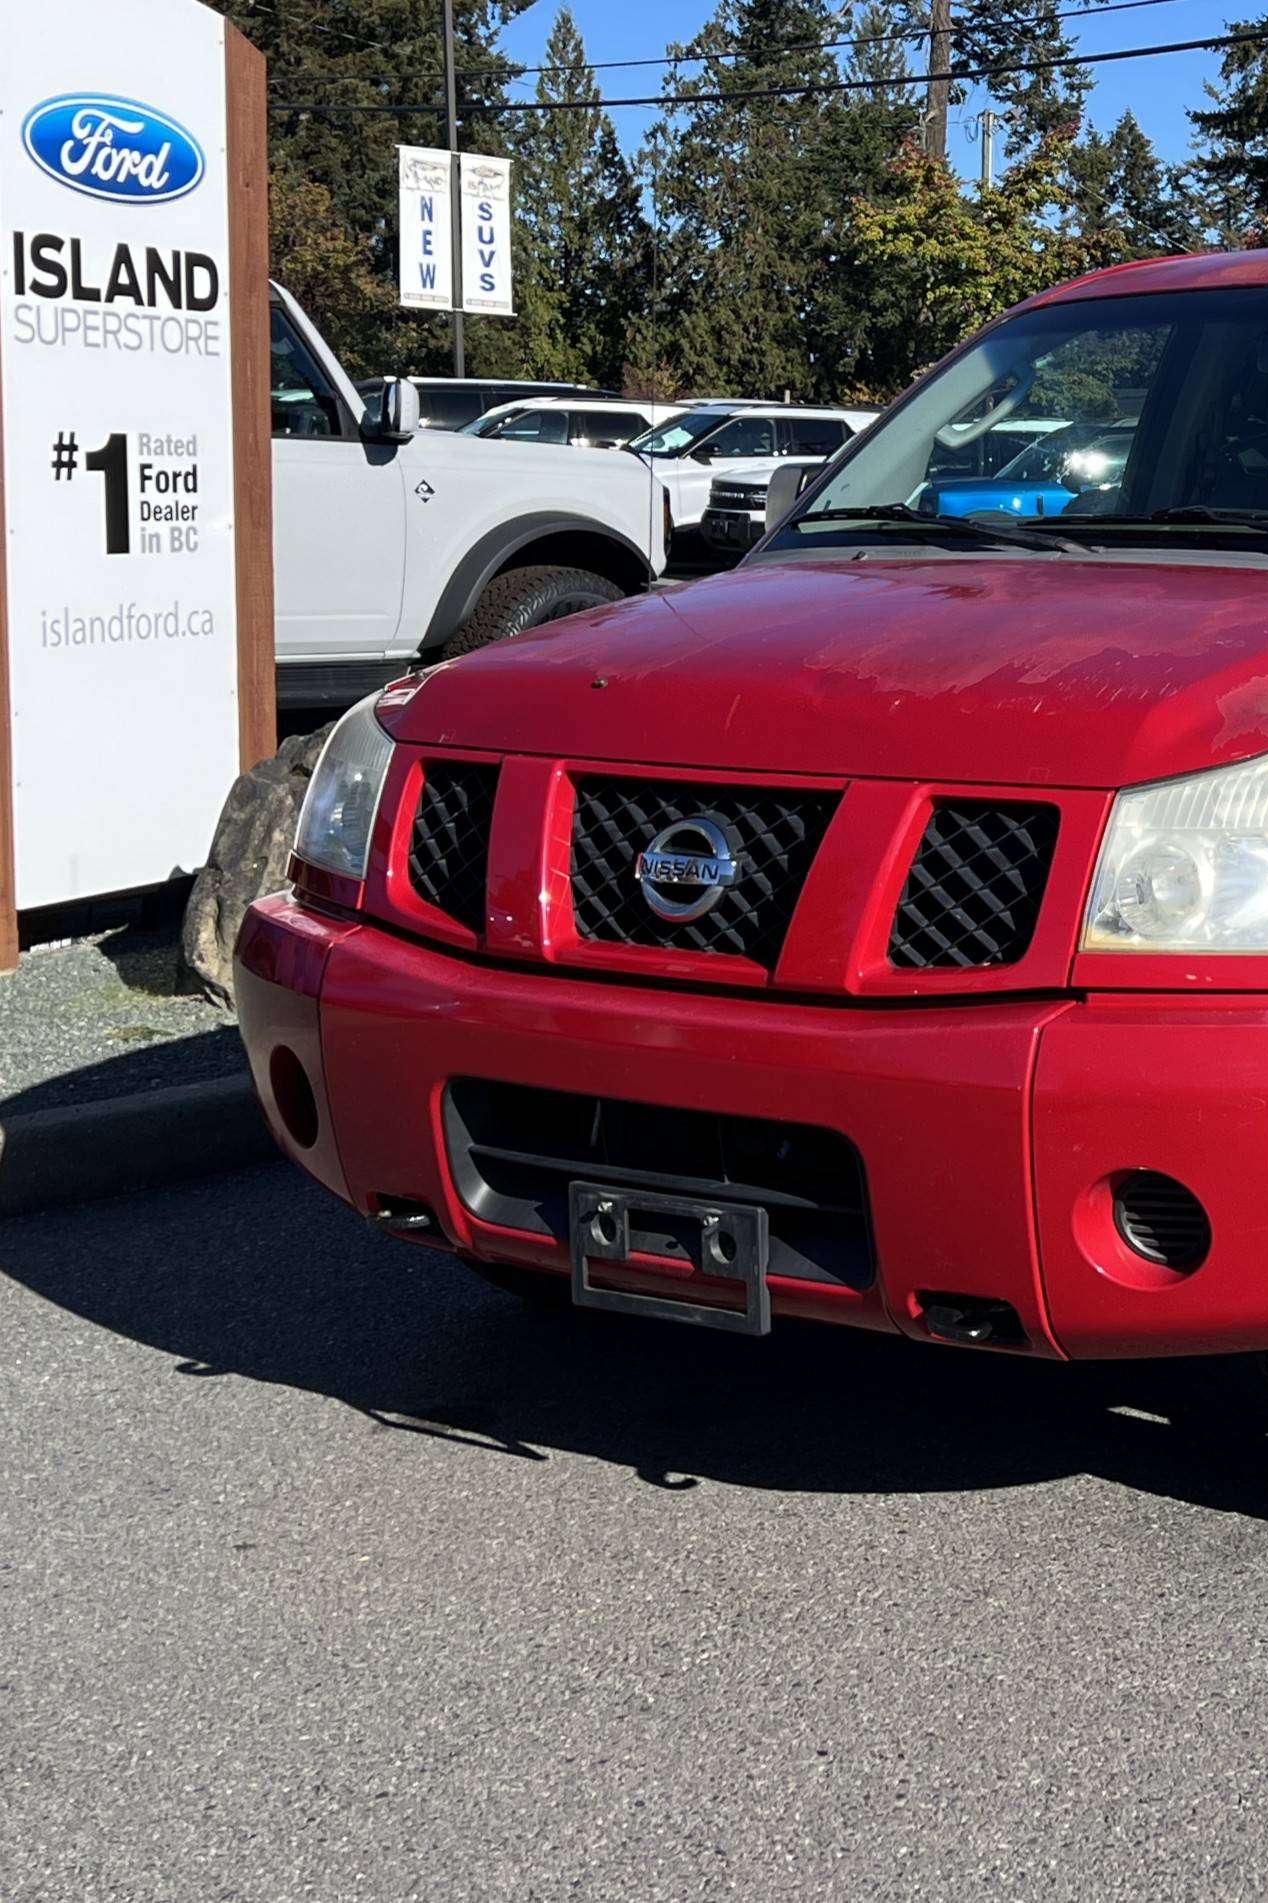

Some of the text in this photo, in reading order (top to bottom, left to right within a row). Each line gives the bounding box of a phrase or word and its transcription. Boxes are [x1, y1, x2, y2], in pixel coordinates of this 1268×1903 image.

[60, 108, 171, 189] Ford
[419, 195, 436, 289] NEW
[477, 202, 495, 292] SUVS
[13, 231, 219, 312] ISLAND
[14, 303, 220, 356] SUPERSTORE
[138, 433, 198, 457] Rated
[51, 431, 130, 555] #1
[139, 463, 199, 494] Ford
[140, 500, 199, 522] Dealer
[139, 526, 199, 553] in BC
[41, 601, 214, 647] islandford.ca
[641, 856, 719, 880] NISSAN
